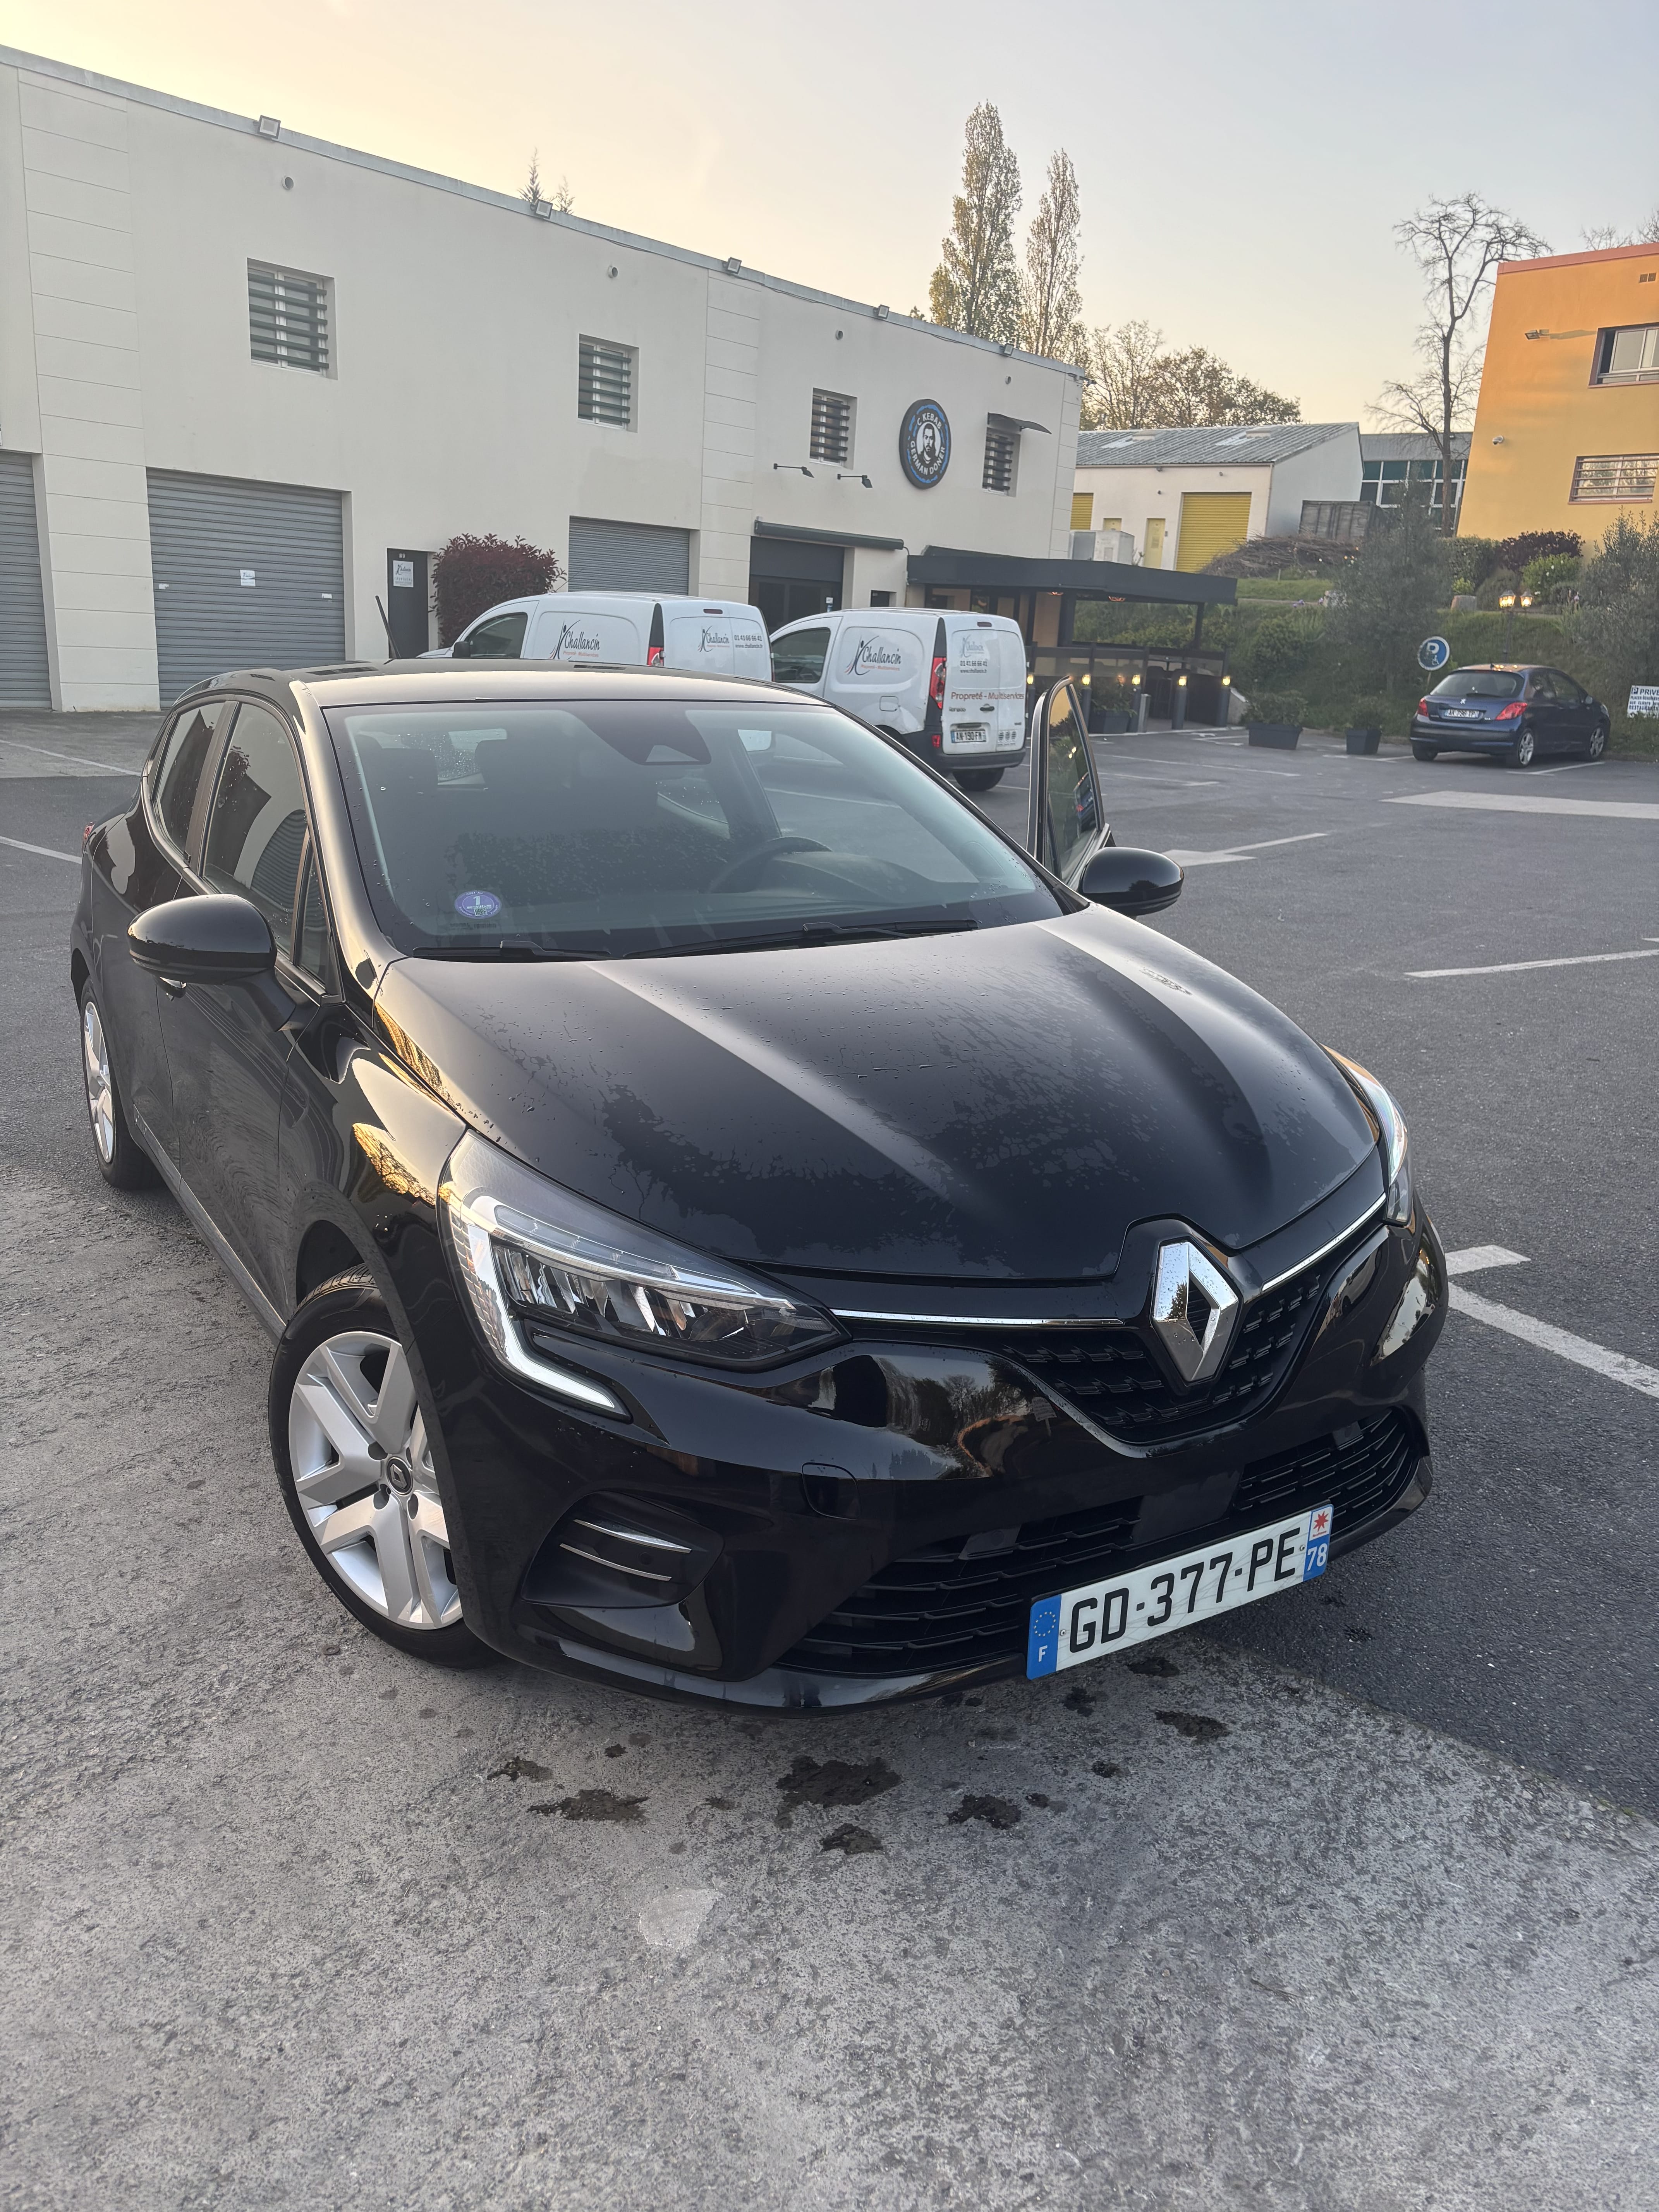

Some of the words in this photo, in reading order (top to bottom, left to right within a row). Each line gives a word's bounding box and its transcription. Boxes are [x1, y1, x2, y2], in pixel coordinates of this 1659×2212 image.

[922, 413, 942, 429] KEBAB
[910, 441, 928, 475] GERMAN
[565, 631, 600, 651] Challancin
[862, 646, 902, 665] Challancin
[951, 692, 983, 701] Propreté
[473, 896, 480, 905] 1
[1307, 1543, 1328, 1571] 78
[1069, 1527, 1301, 1653] GD-377-PE
[1038, 1645, 1048, 1662] F
